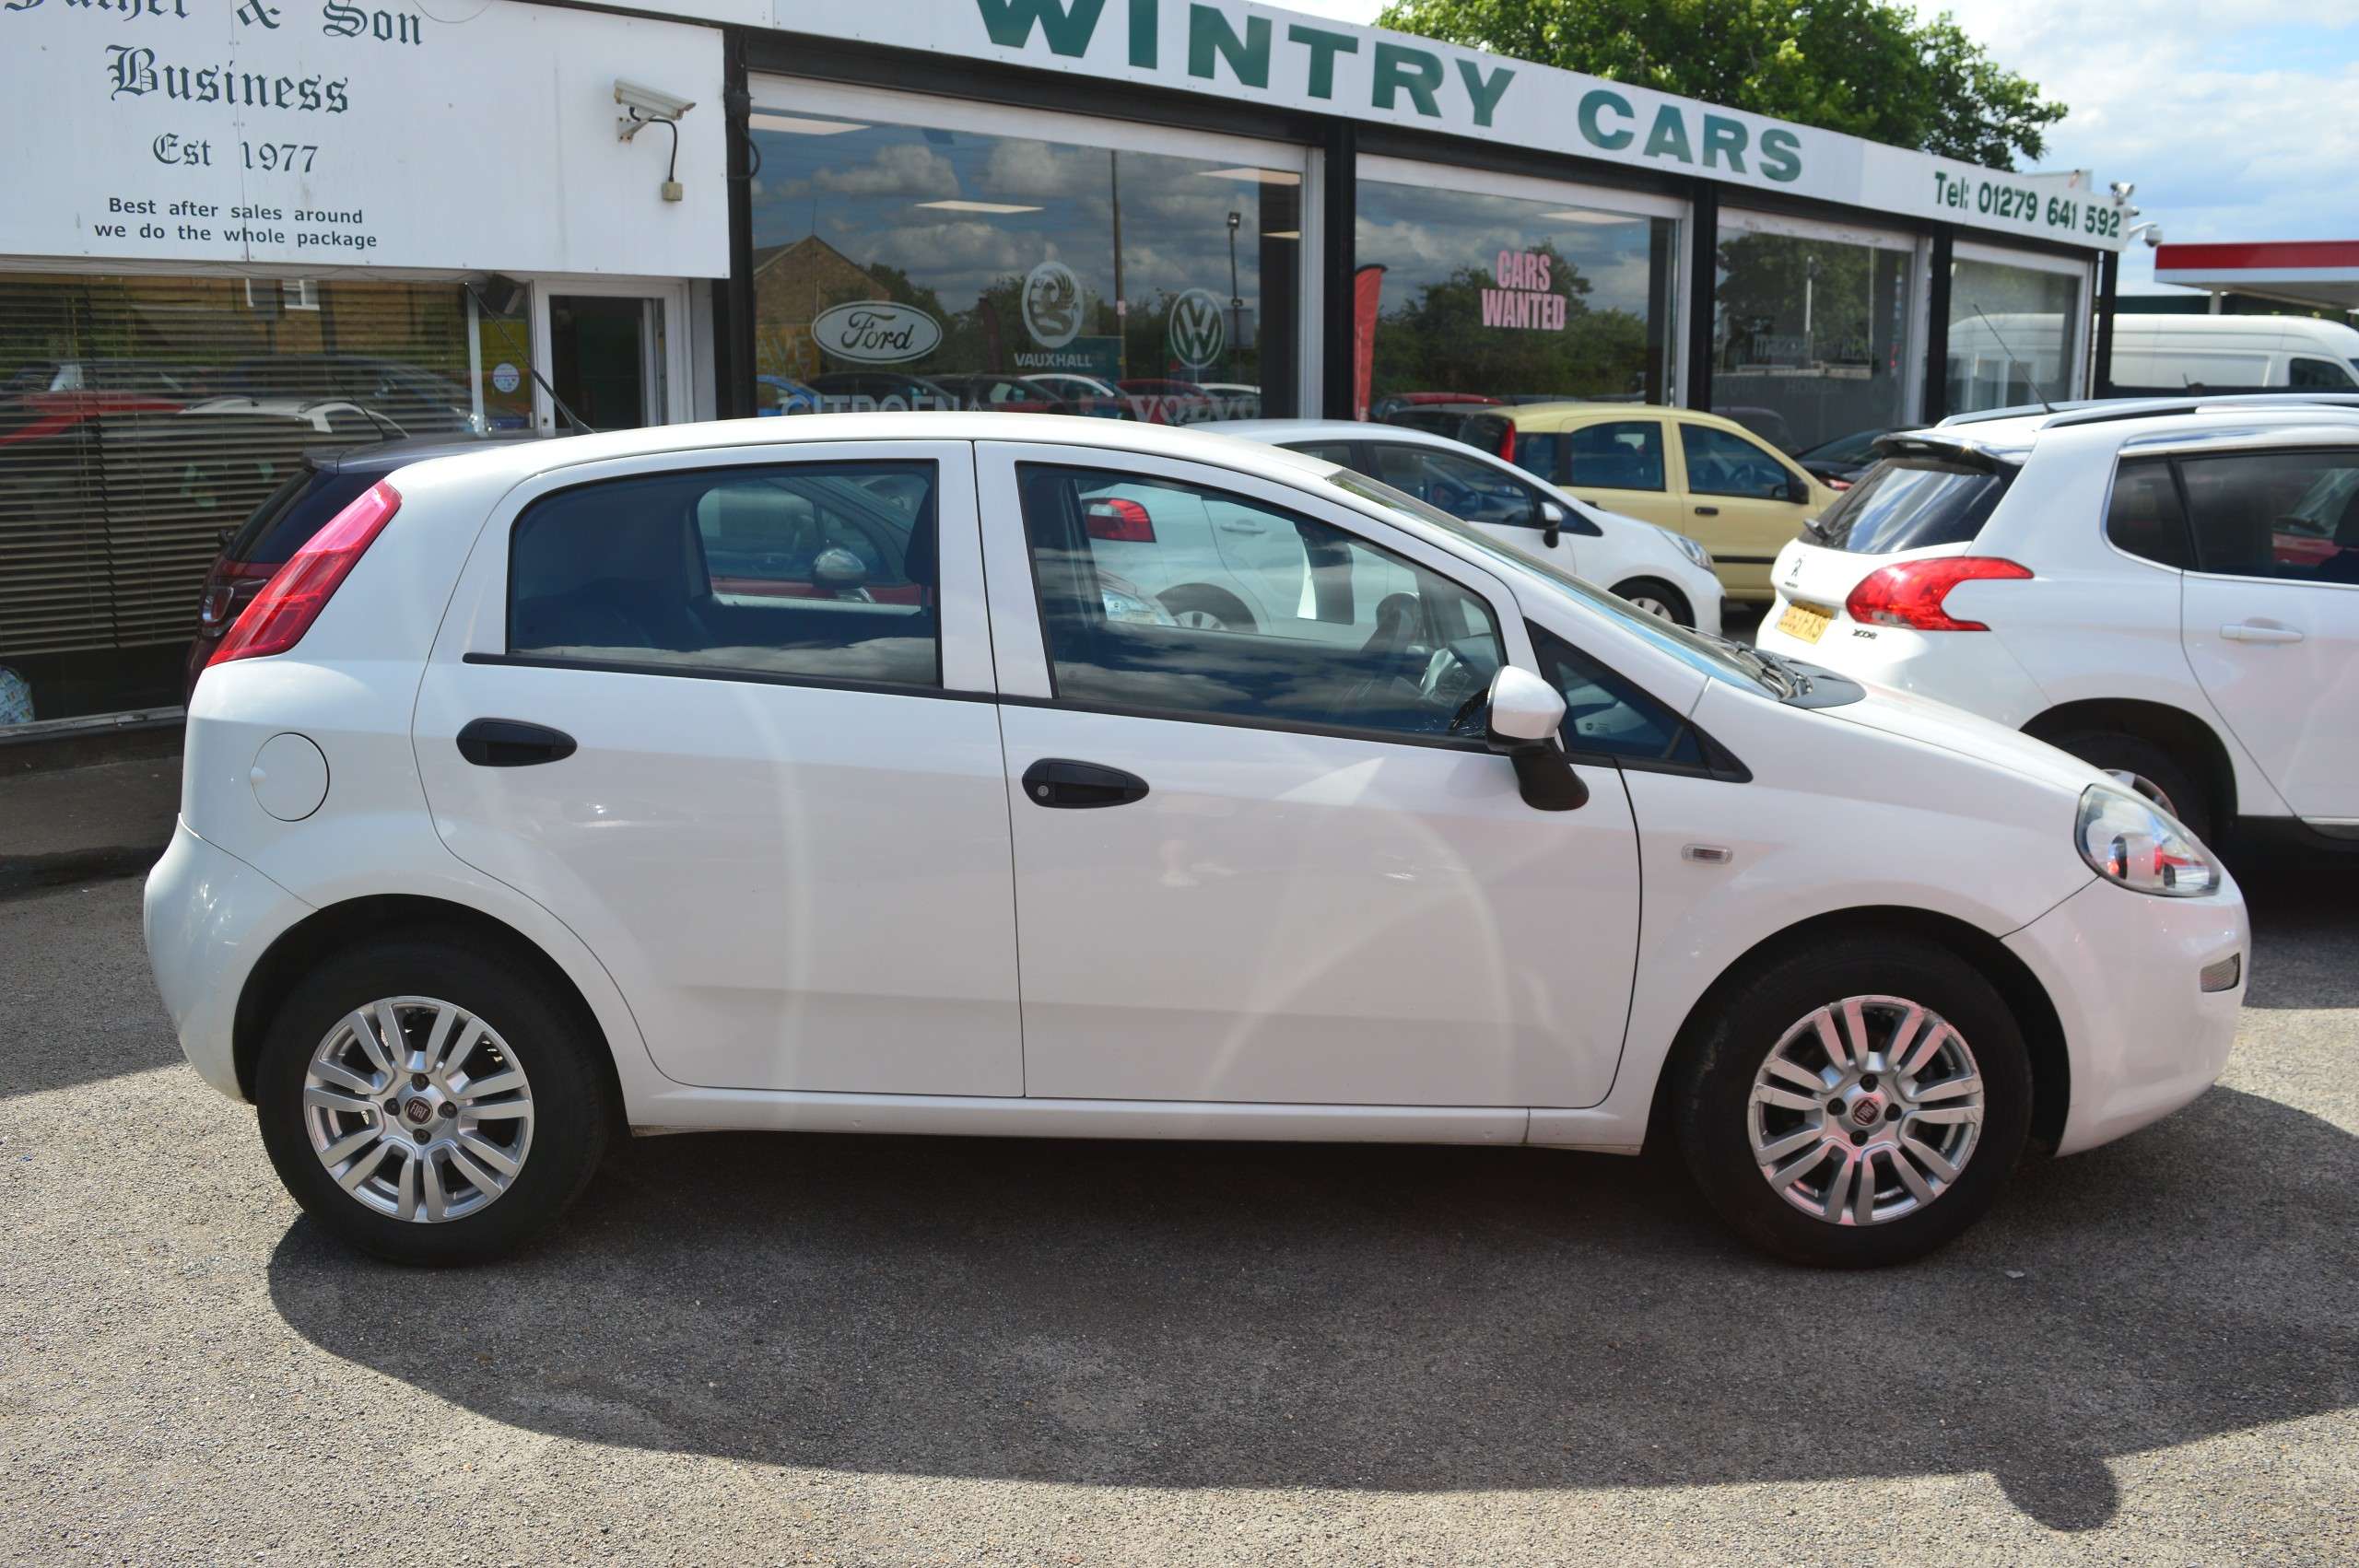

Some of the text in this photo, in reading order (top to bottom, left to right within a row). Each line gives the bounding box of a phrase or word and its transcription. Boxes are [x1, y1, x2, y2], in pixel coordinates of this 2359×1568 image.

[323, 0, 424, 46] Son
[105, 44, 350, 114] Business
[977, 0, 1802, 183] WINTRY CARS
[152, 133, 319, 173] Est 1977
[109, 197, 363, 224] Best after sales around
[1935, 171, 2120, 238] Tel: 01279 641 592
[94, 223, 377, 250] we do the whole package
[1496, 250, 1551, 291] CARS
[1482, 287, 1566, 330] WANTED
[840, 310, 915, 350] Ford
[1014, 353, 1093, 368] VAUXHALL
